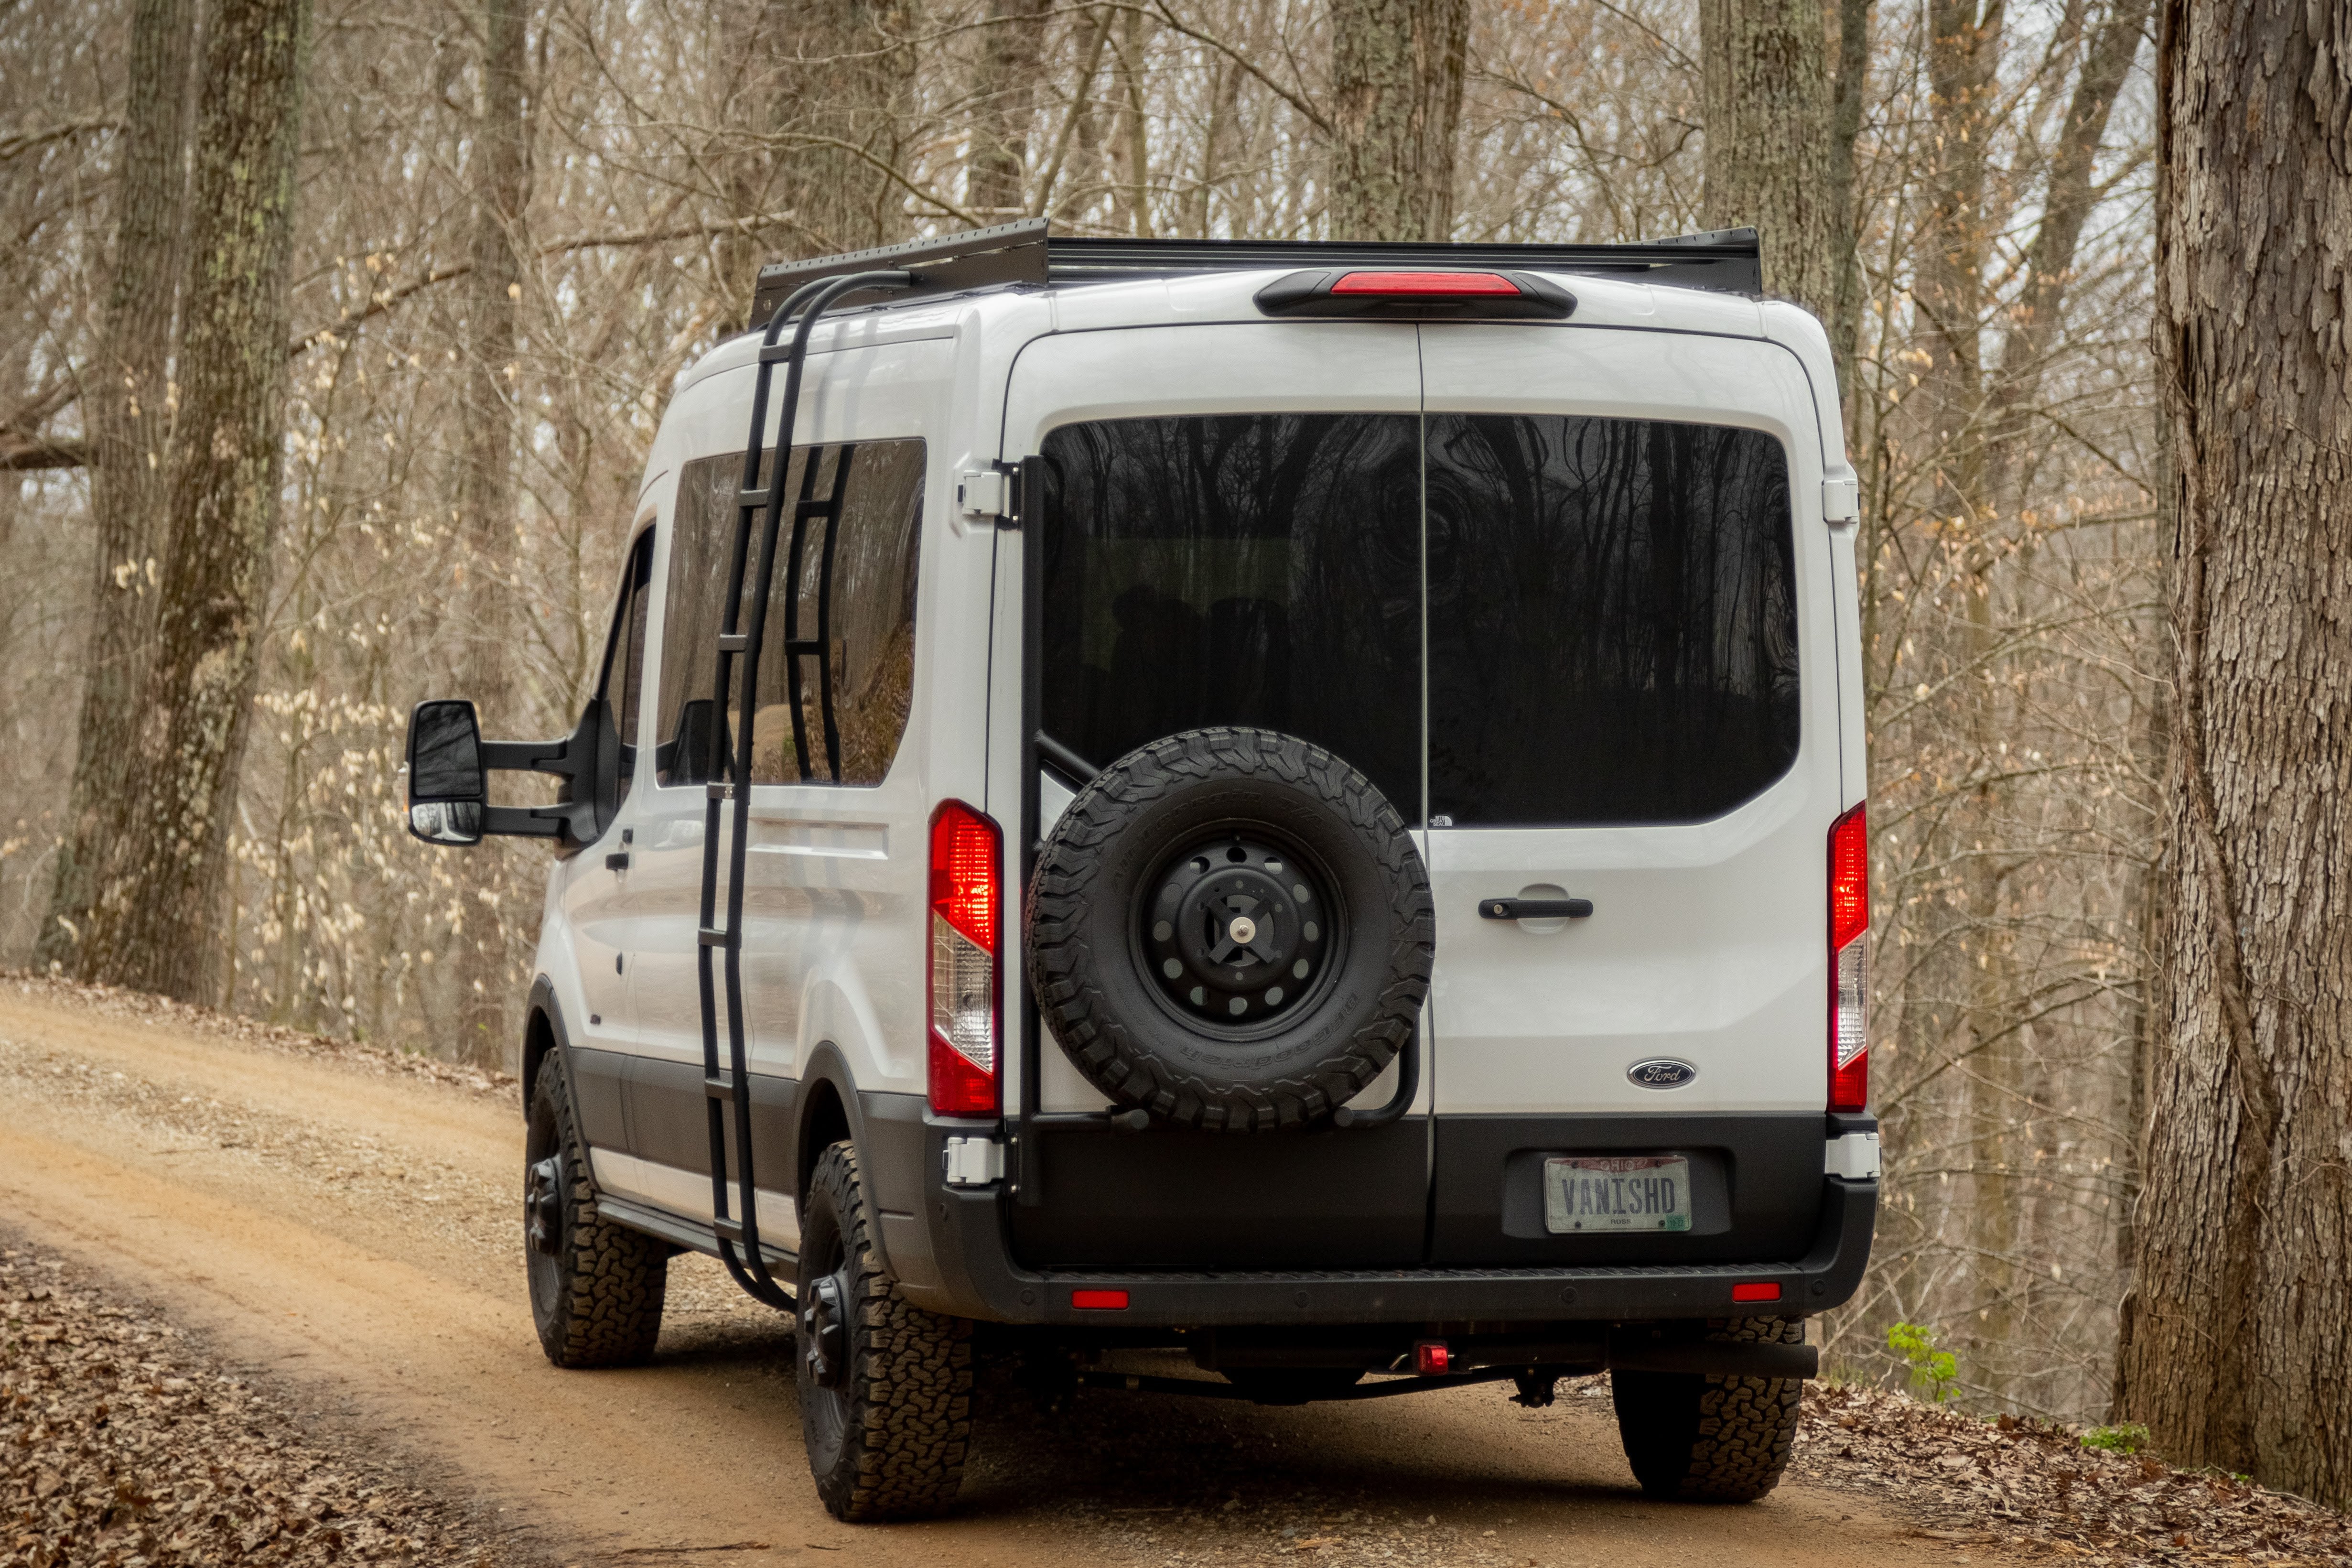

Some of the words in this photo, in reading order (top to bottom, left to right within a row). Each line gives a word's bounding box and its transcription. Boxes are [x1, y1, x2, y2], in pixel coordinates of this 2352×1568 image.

[1179, 993, 1359, 1071] BFGoodrich
[1644, 1065, 1681, 1081] Ford
[1600, 1159, 1634, 1171] OHIO
[1562, 1178, 1675, 1214] VANISHD
